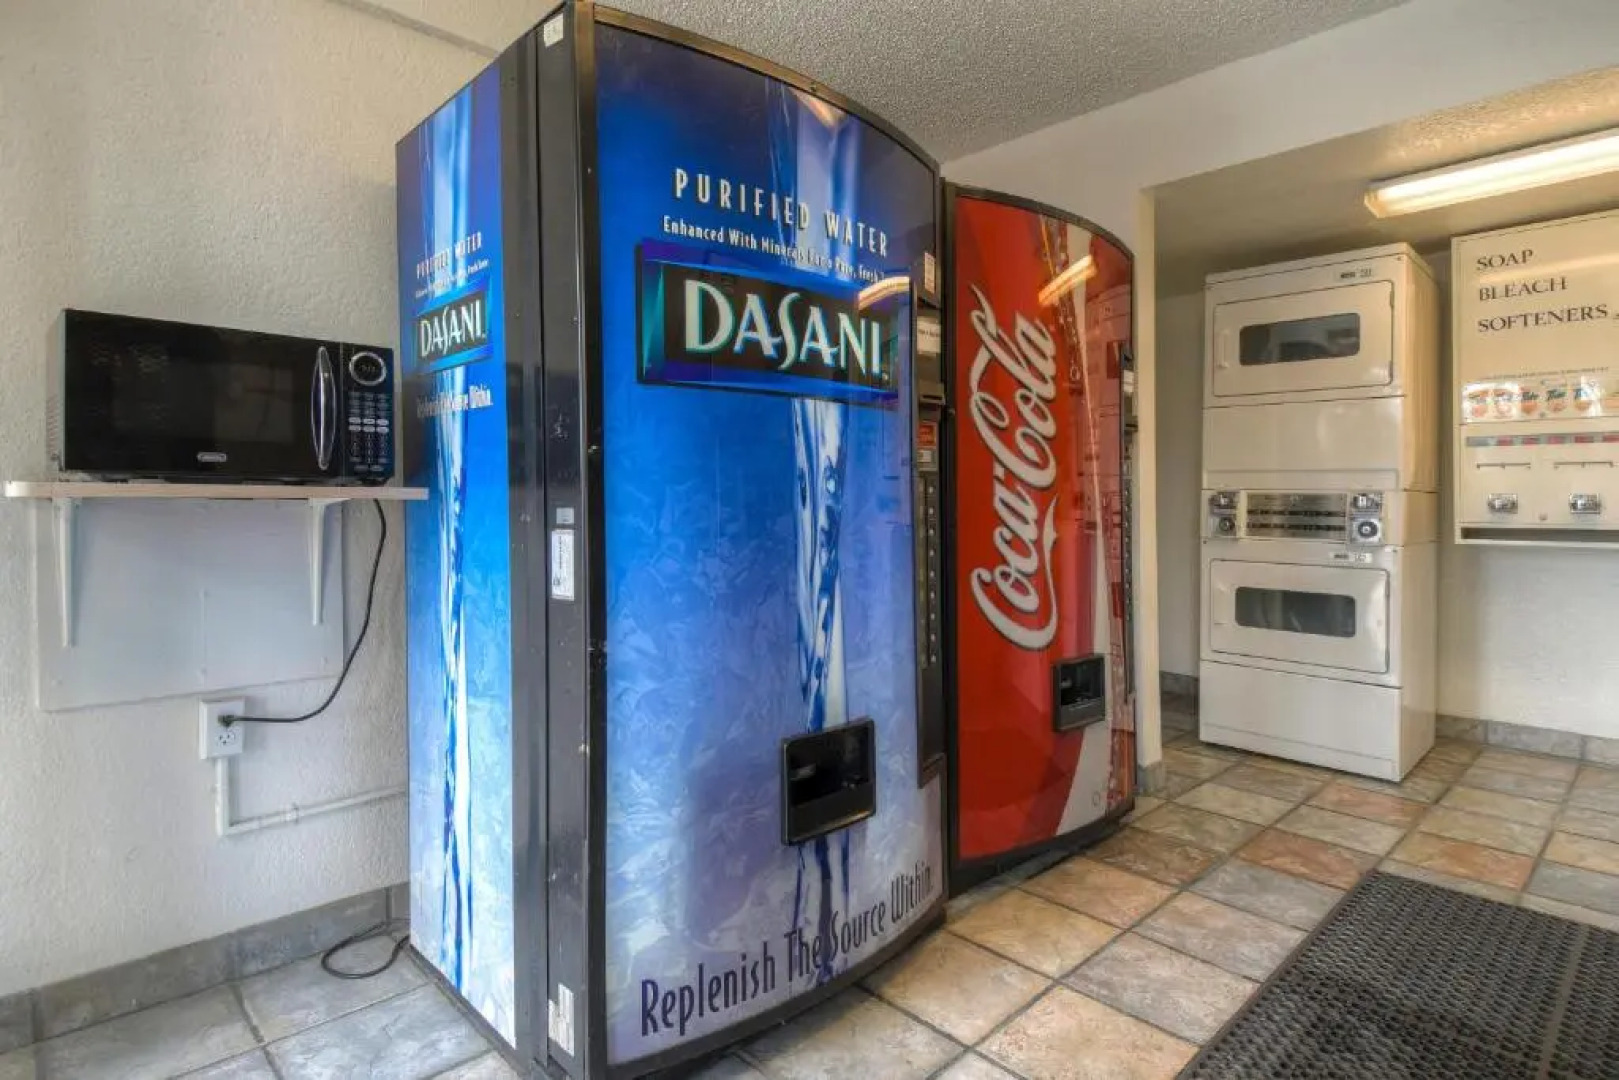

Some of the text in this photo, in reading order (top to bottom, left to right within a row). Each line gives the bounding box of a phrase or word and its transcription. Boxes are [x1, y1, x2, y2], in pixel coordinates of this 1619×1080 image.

[663, 214, 724, 243] Enhanced
[728, 227, 757, 250] With
[674, 168, 888, 258] PURIFIED WATER
[1476, 249, 1534, 271] SOAP
[1479, 276, 1568, 301] BLEACH
[420, 299, 483, 358] DASANI
[685, 279, 882, 377] DASANI
[1477, 303, 1609, 333] SOFTENERS
[970, 284, 1057, 650] Coca-Cola
[641, 941, 775, 1037] Replenish
[784, 927, 821, 983] The
[829, 909, 886, 962] Source
